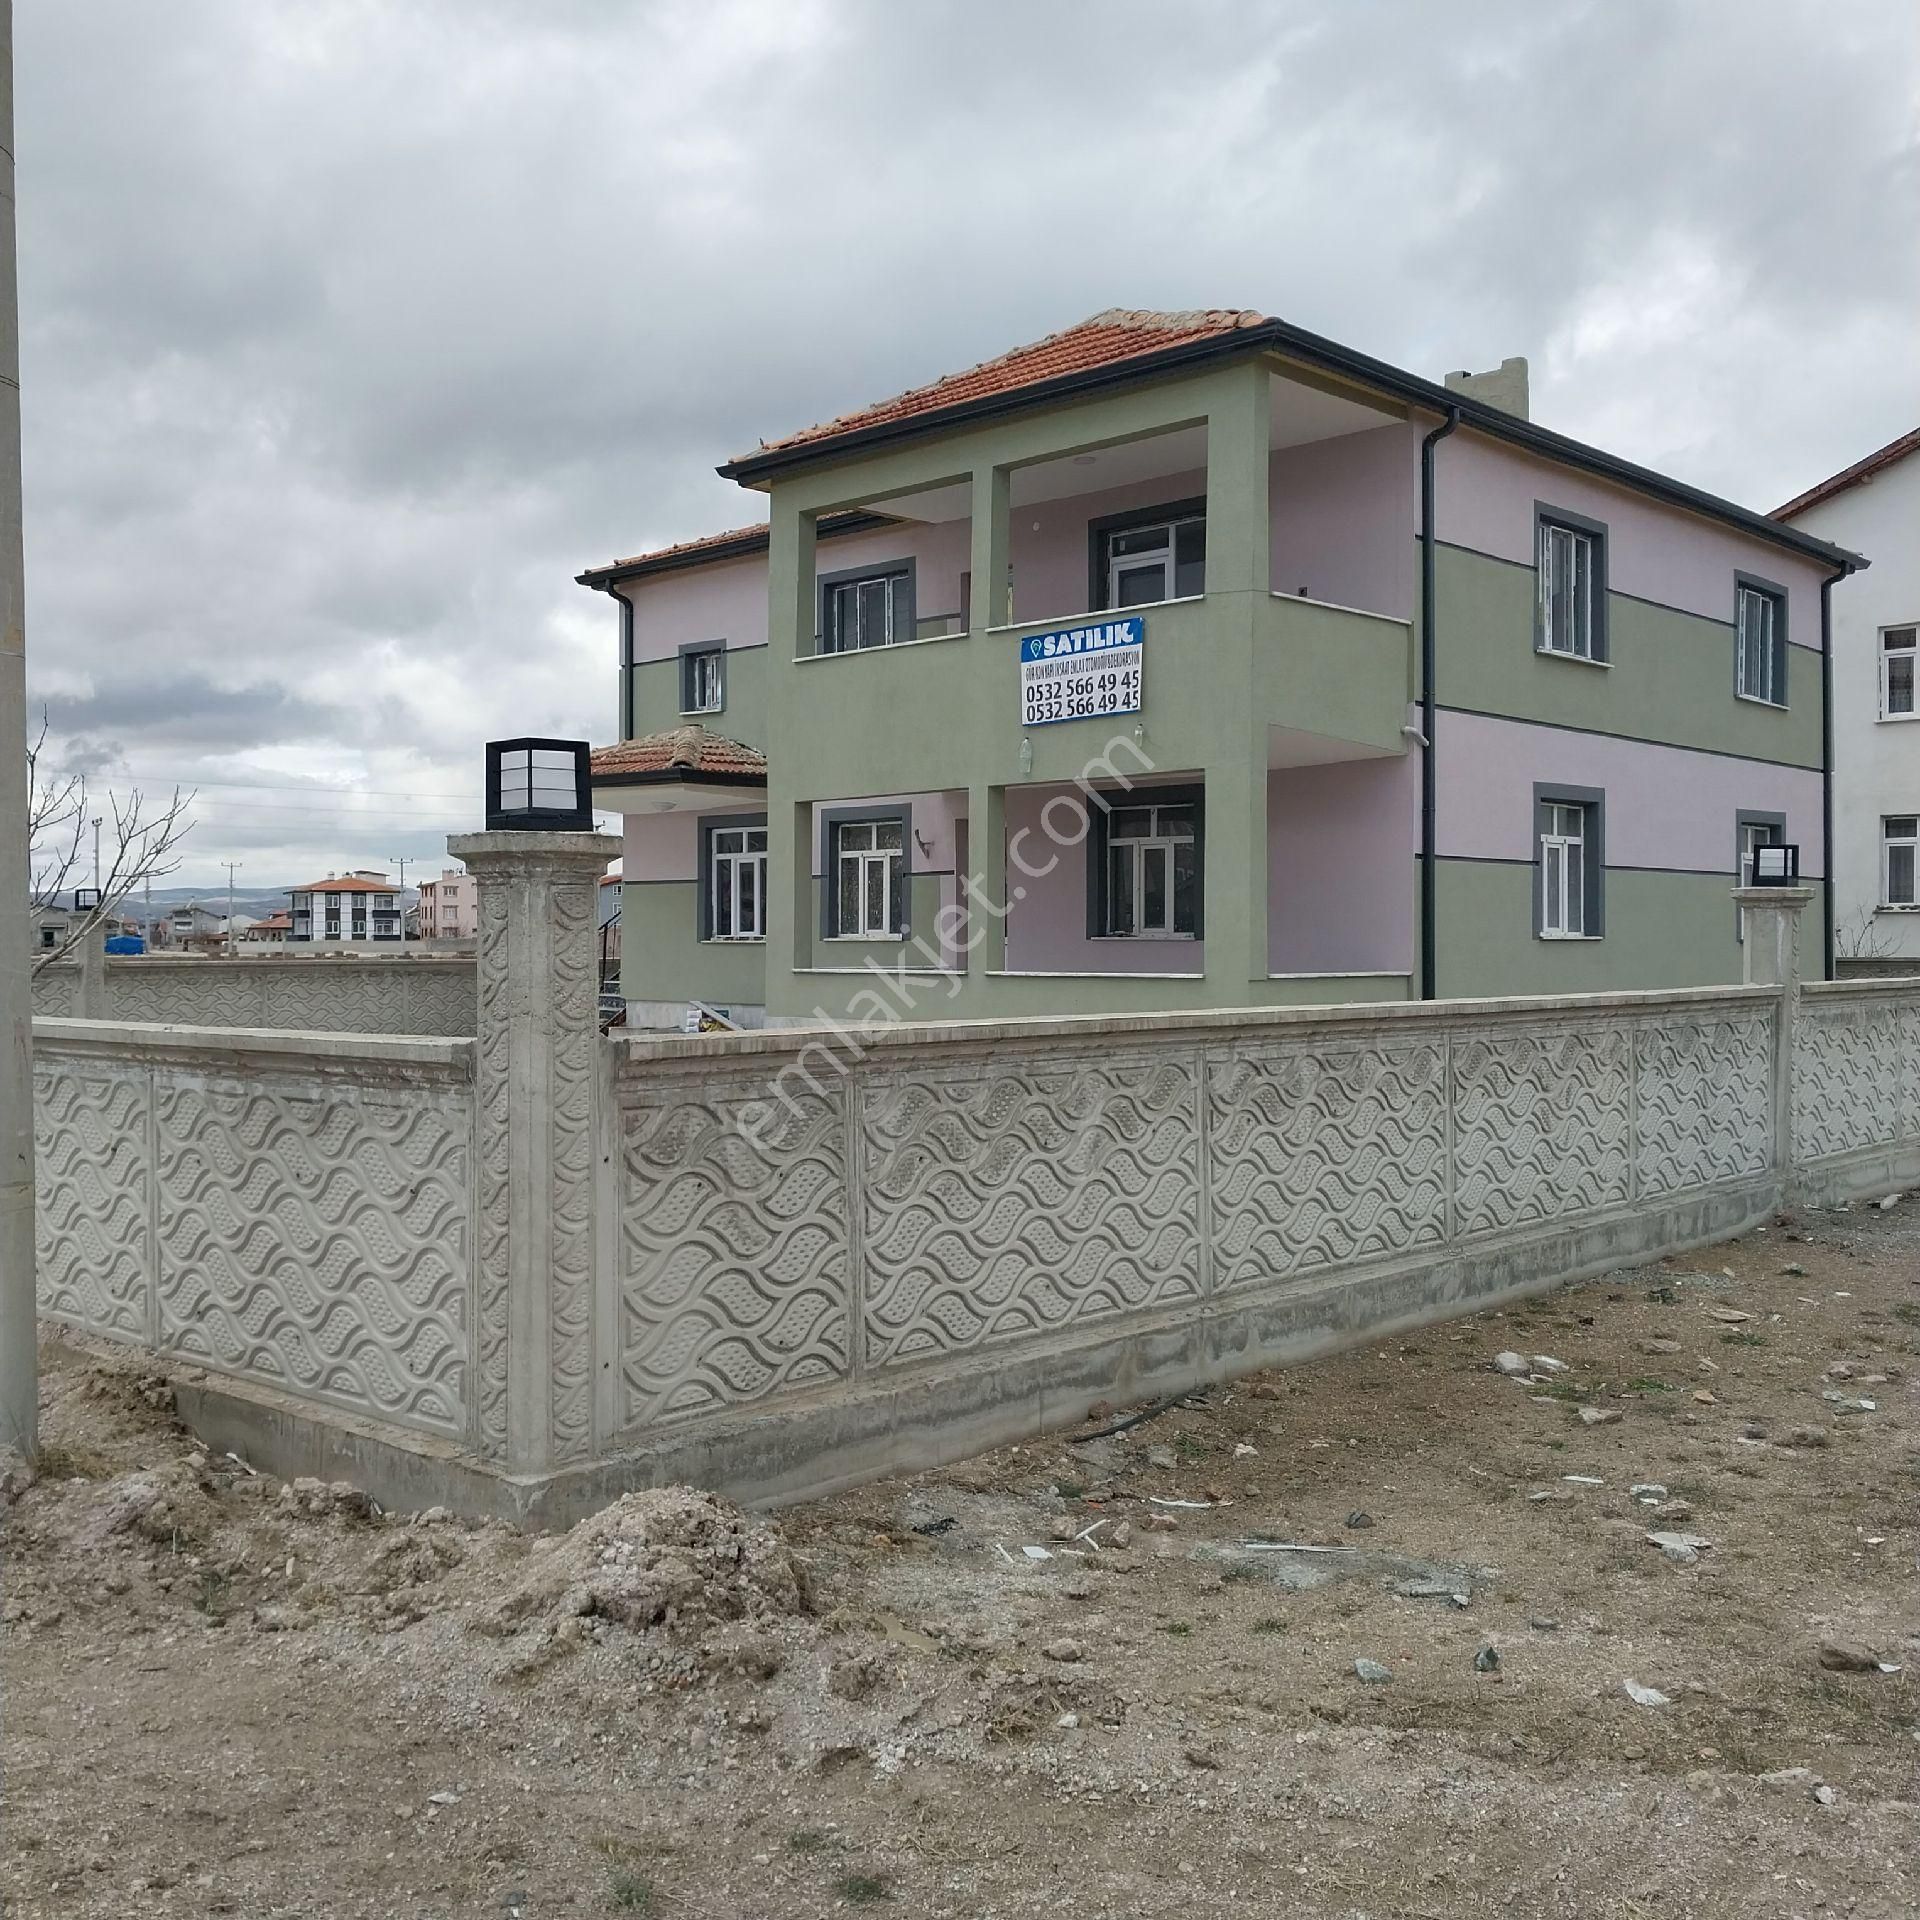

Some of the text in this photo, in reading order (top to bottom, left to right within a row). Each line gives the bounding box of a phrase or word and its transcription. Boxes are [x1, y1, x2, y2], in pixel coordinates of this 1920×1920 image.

[1043, 622, 1134, 657] SATILIK
[1026, 669, 1139, 703] 0532 566 49 45
[1026, 689, 1139, 722] 0532 566 49 45
